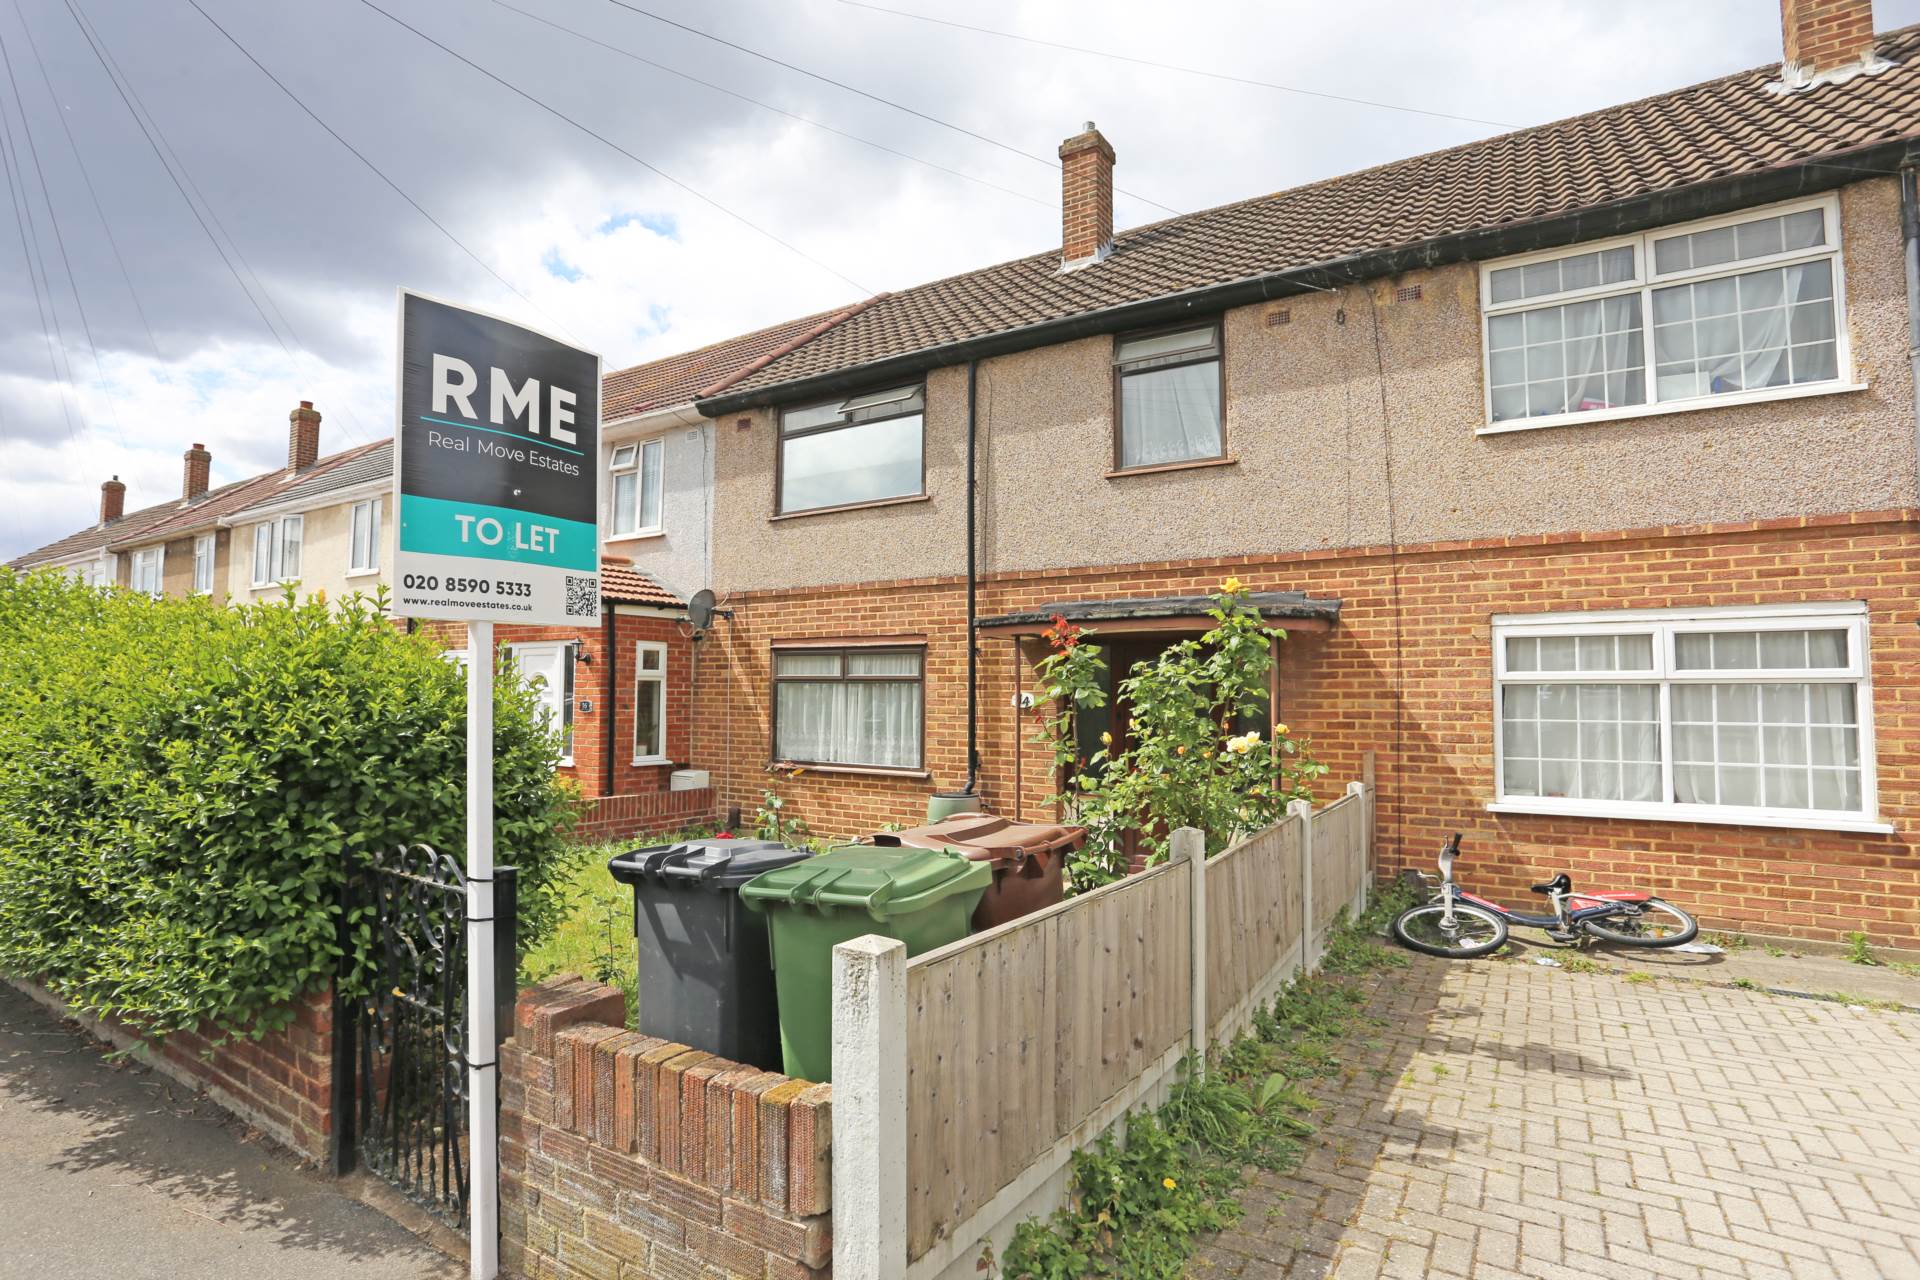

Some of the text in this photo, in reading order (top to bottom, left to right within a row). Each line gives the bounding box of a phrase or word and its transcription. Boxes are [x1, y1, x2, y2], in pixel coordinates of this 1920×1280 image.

[431, 353, 577, 445] RME
[428, 430, 580, 477] Real Move Estates
[454, 514, 560, 554] TO LET
[403, 573, 532, 598] 020 8590 5333
[403, 597, 533, 611] www.realmoveestates.co.uk
